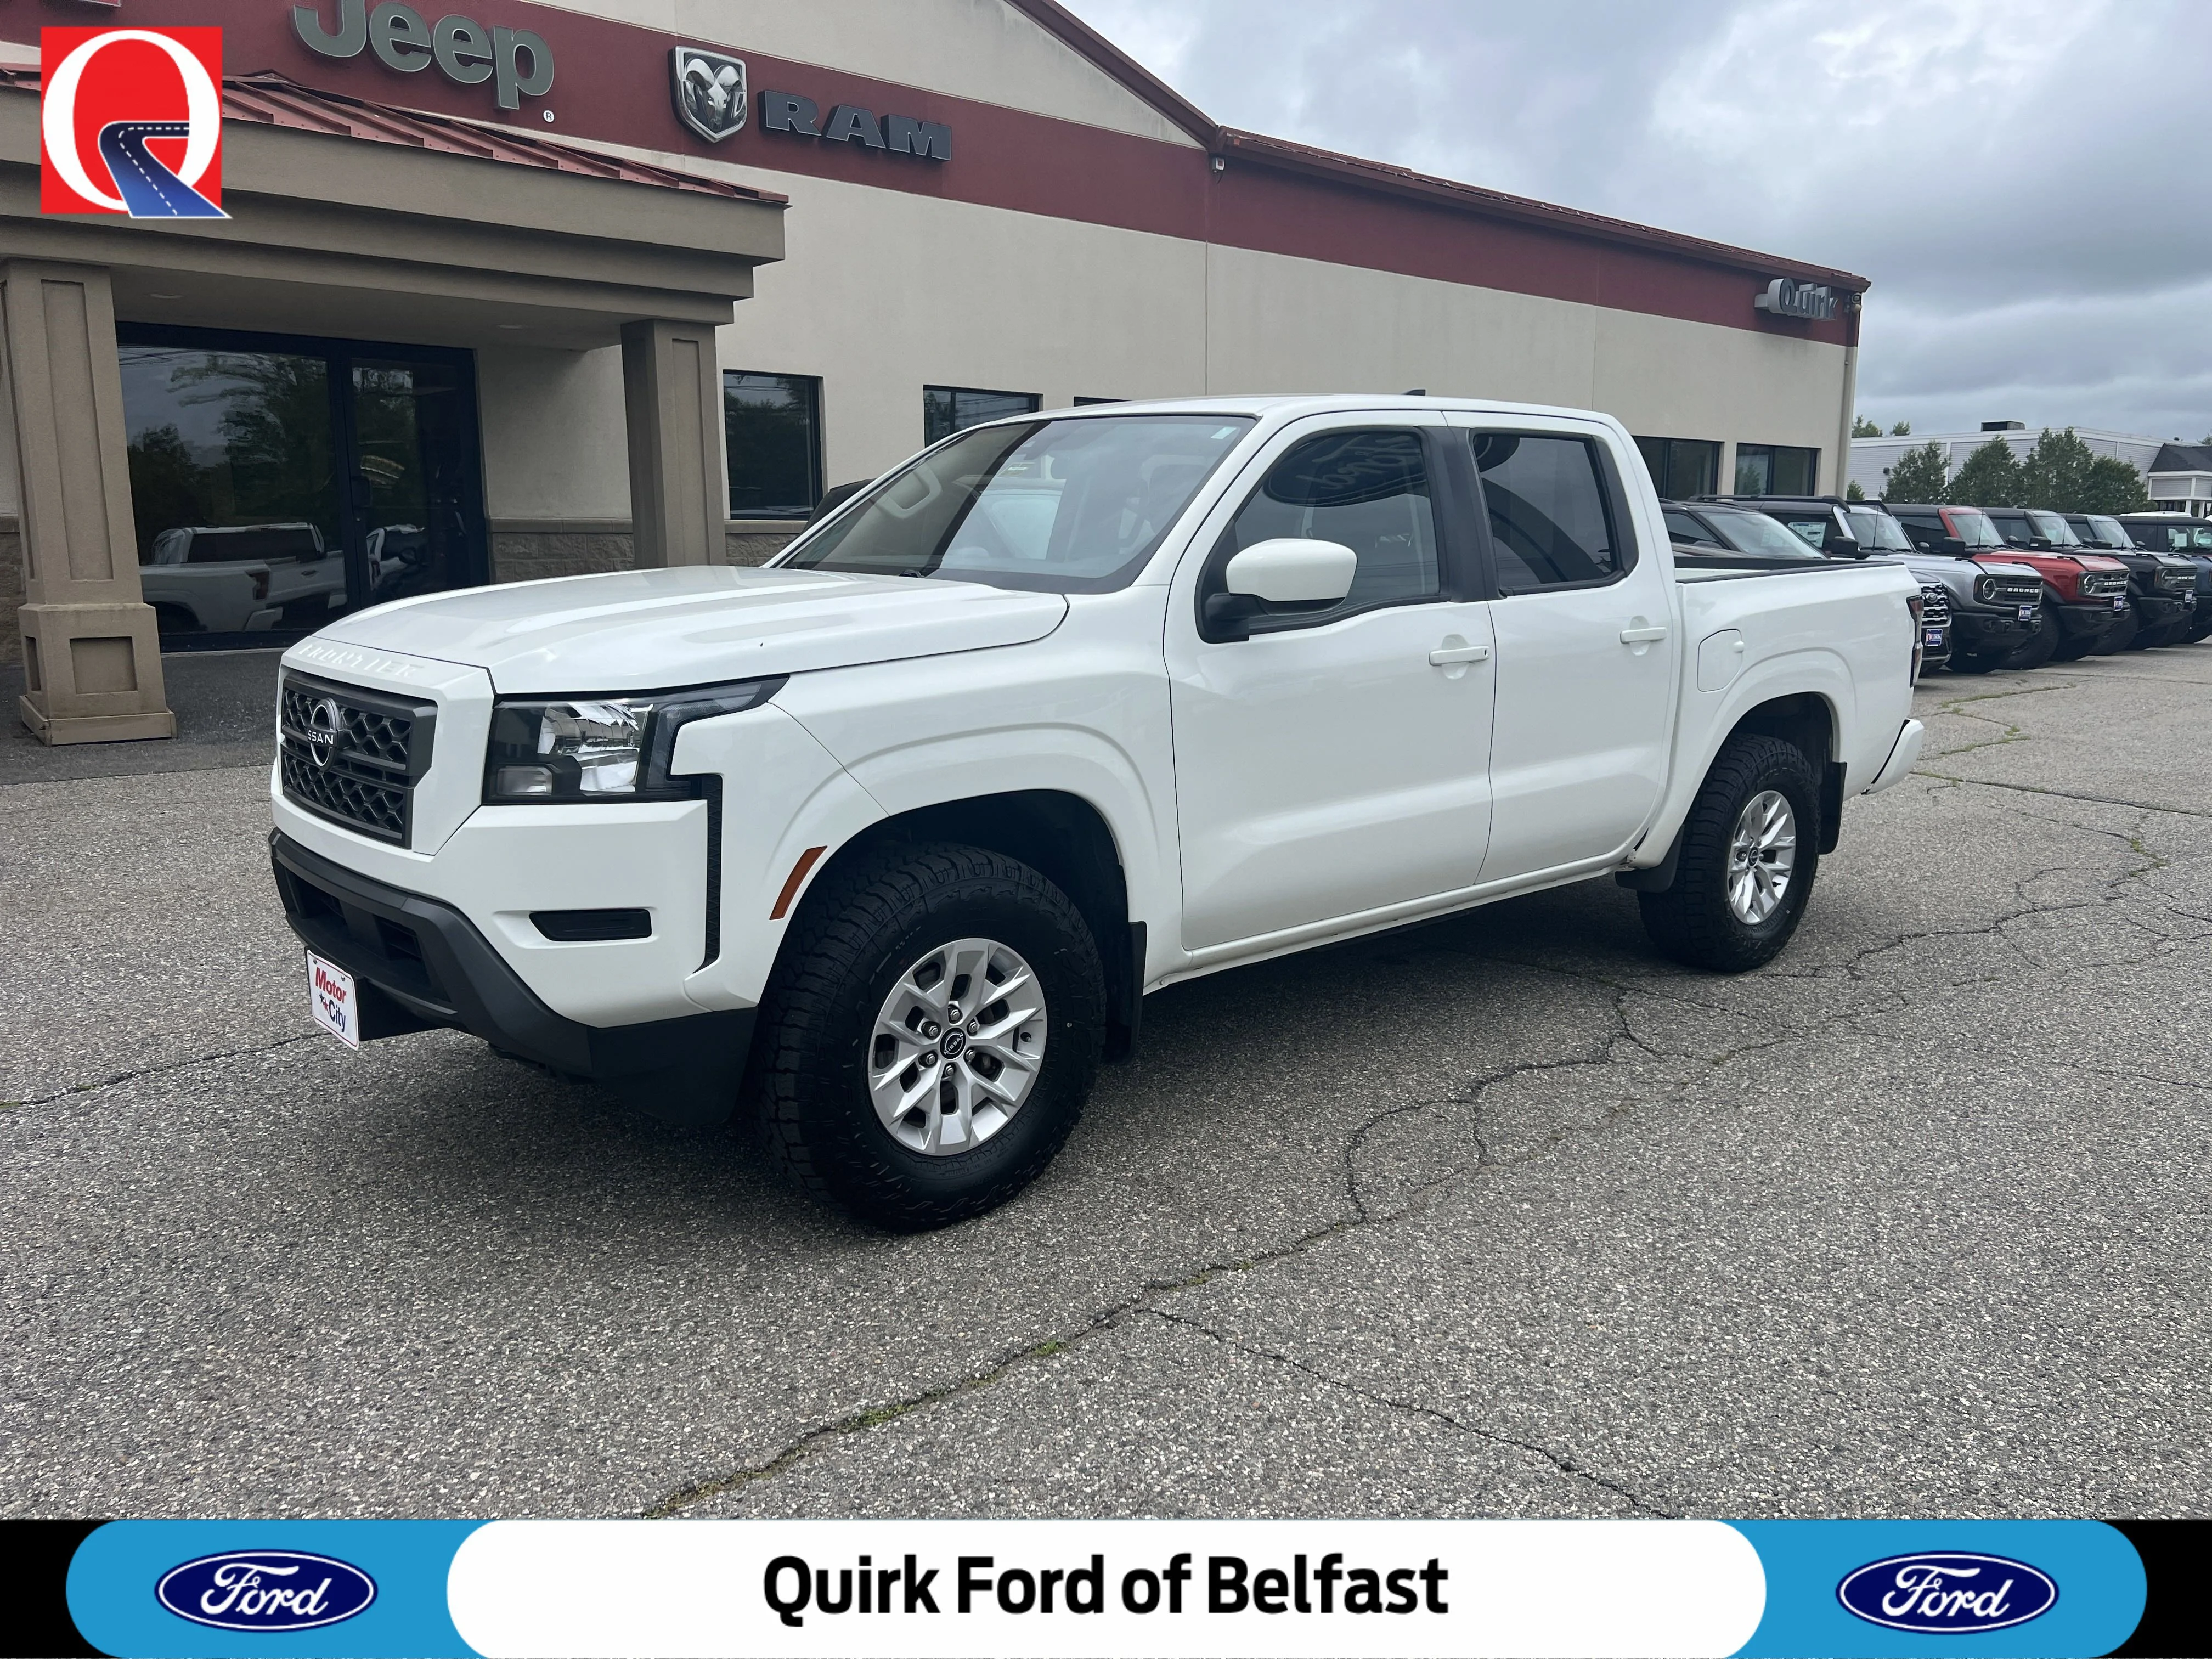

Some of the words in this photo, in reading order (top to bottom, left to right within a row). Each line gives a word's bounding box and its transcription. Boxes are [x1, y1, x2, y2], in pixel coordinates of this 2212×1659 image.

[291, 0, 555, 110] Jeep
[759, 90, 951, 161] RAM
[1770, 278, 1838, 320] Quirk
[315, 967, 347, 1004] Motor
[329, 999, 346, 1032] City
